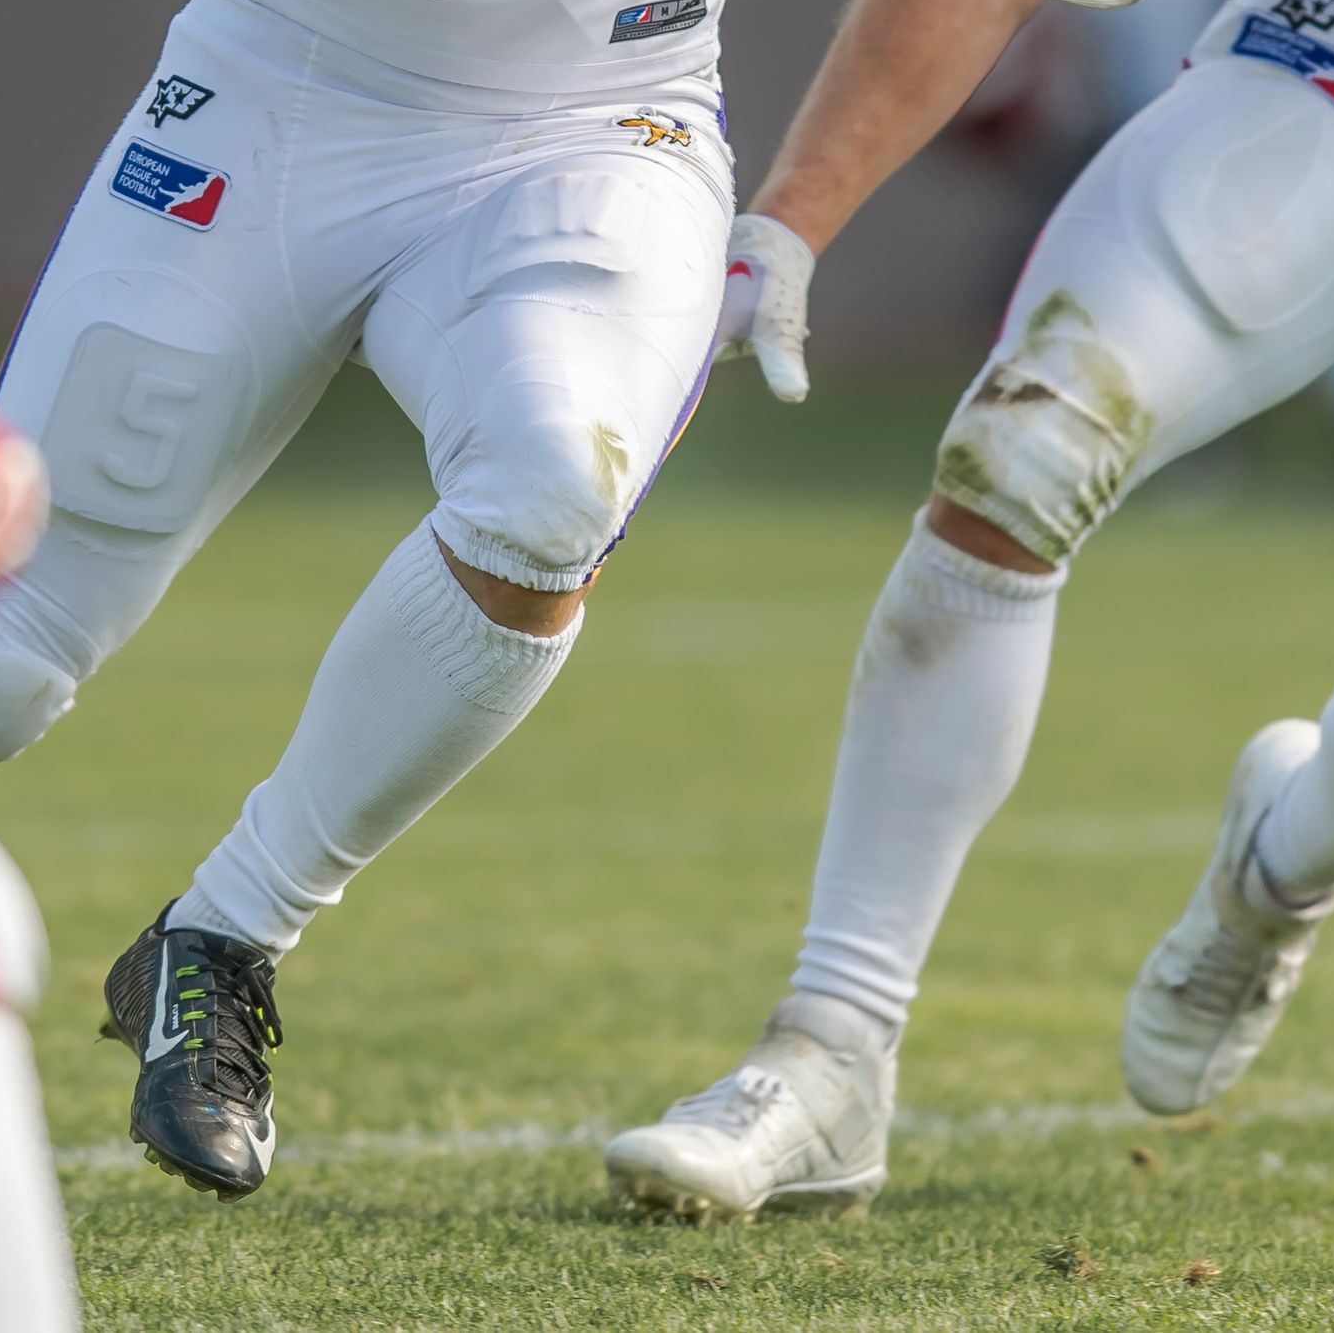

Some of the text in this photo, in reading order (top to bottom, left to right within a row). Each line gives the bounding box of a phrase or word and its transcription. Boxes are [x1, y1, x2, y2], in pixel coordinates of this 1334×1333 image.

[123, 163, 153, 183] LEAGUE
[128, 150, 171, 177] EUROPEAN
[117, 174, 157, 200] FOOTBALL
